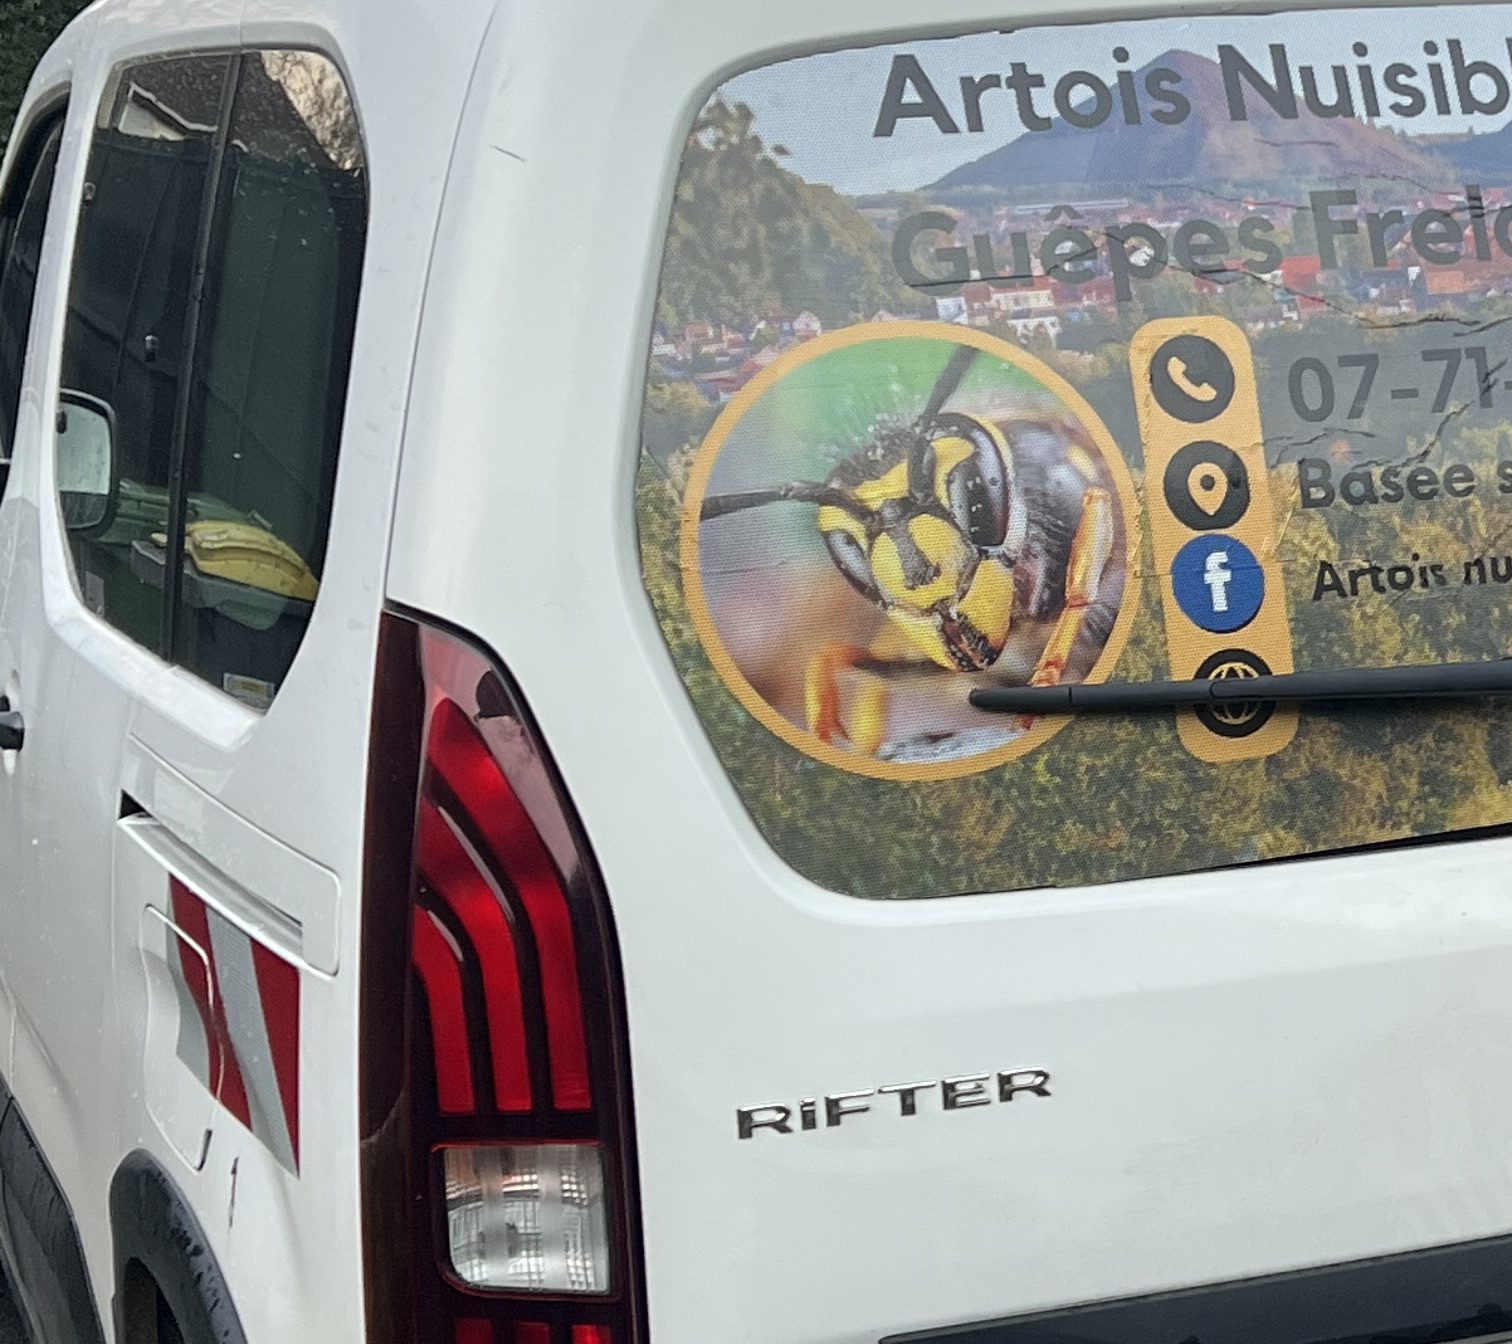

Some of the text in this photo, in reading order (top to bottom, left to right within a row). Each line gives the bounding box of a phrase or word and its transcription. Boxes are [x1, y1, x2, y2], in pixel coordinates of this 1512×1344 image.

[873, 46, 1192, 138] Artois
[891, 205, 1282, 302] Guêpes
[1313, 553, 1444, 601] Artois
